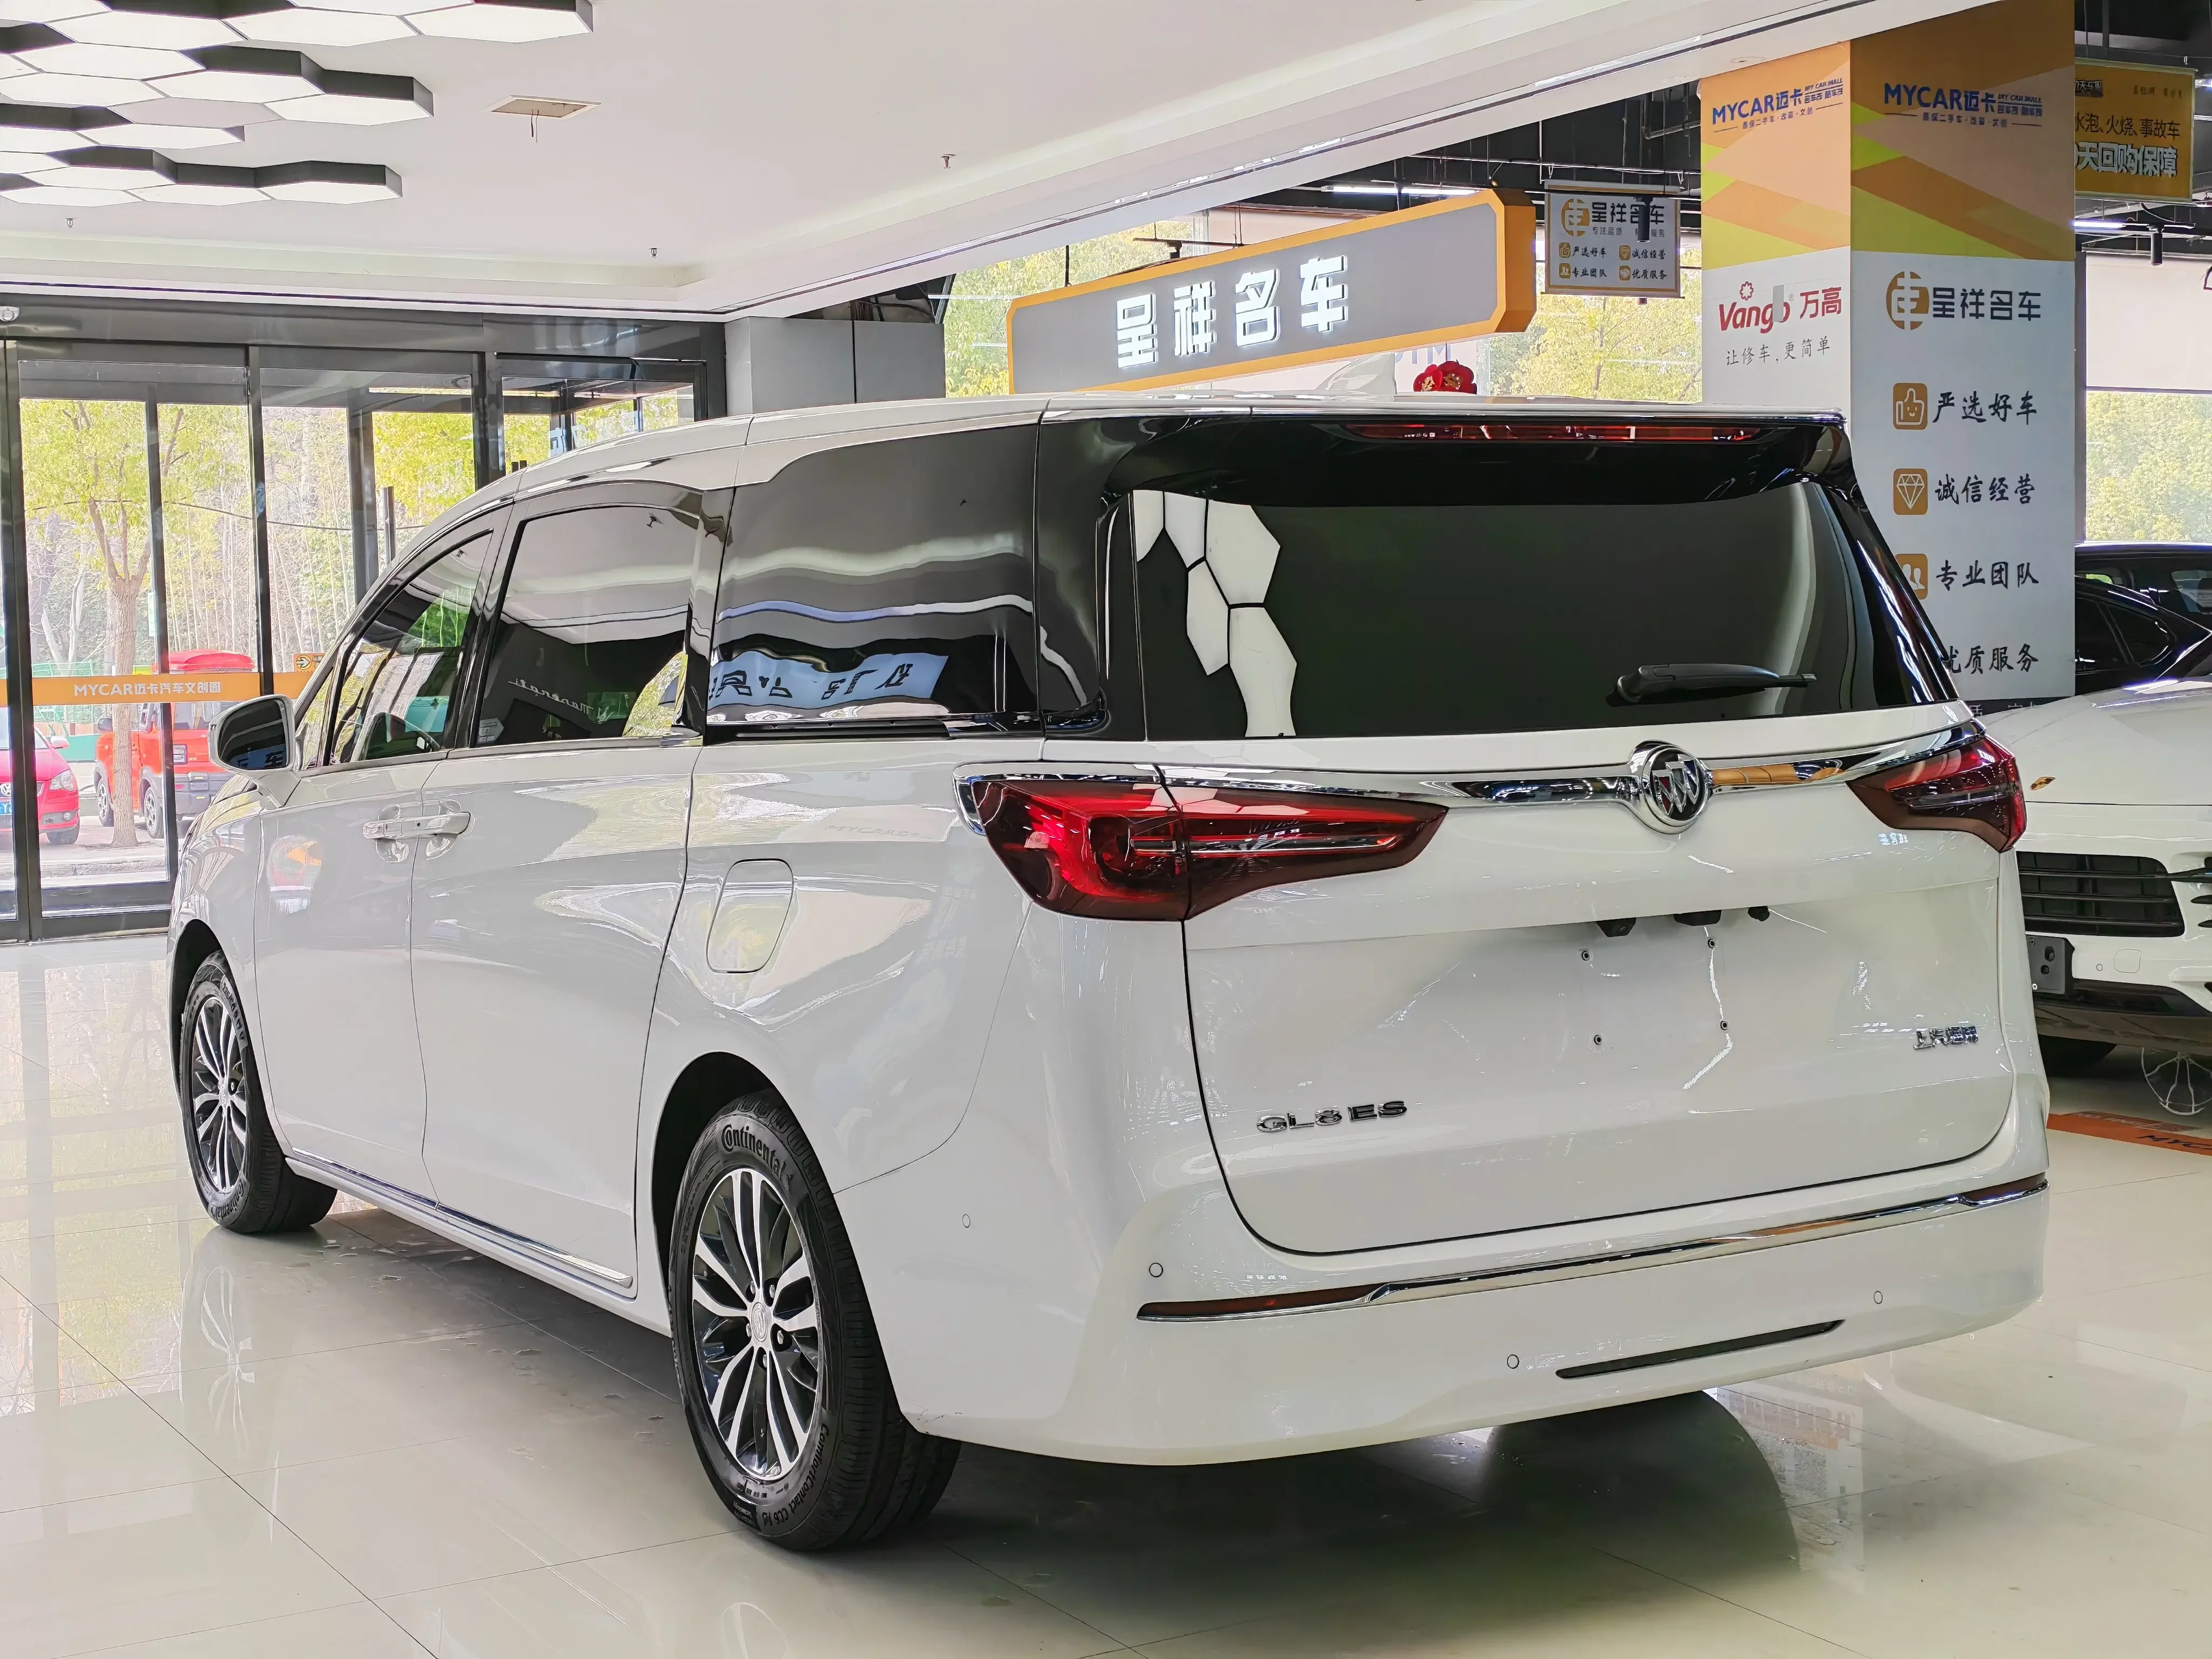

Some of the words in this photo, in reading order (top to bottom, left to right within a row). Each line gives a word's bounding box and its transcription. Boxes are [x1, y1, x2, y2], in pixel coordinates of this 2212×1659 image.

[1572, 246, 1607, 259] 严选好车
[1632, 249, 1667, 260] 诚信经营
[1572, 267, 1608, 279] 专业团队
[1633, 269, 1667, 280] 优质服务
[1116, 254, 1348, 369] 呈祥名车
[1800, 287, 1842, 320] 万高
[1933, 287, 2041, 321] 呈祥名车
[1933, 390, 2037, 425] 严选好车
[1934, 474, 2035, 505] 诚信经营
[1936, 559, 2039, 591] 专业团队
[1256, 1107, 1343, 1132] GL8
[1347, 1100, 1407, 1122] ES
[721, 1124, 787, 1181] Continental
